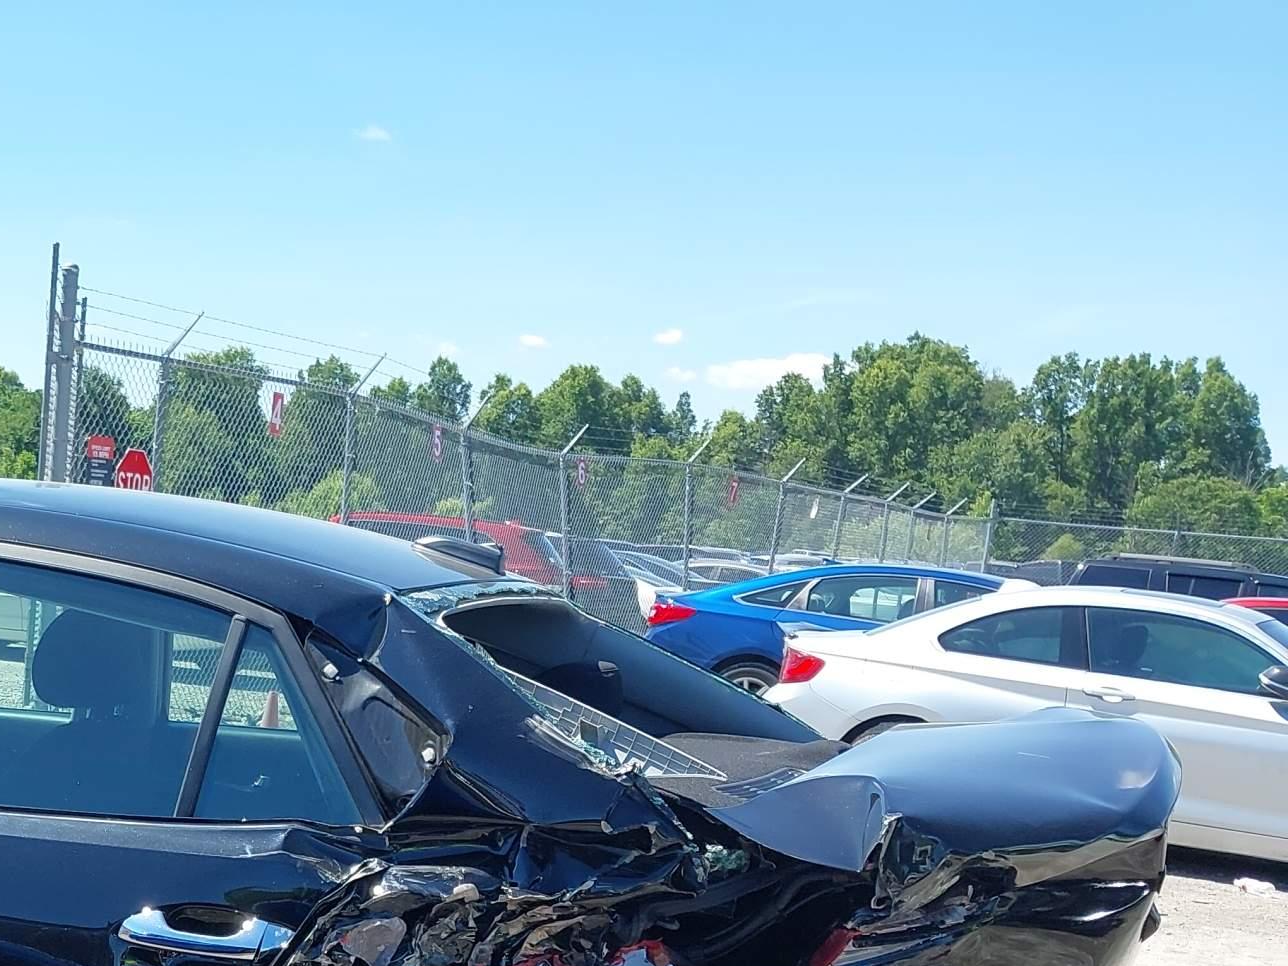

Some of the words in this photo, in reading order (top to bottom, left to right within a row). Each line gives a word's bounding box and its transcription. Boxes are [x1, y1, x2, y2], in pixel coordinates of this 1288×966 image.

[272, 399, 282, 430] 4
[434, 430, 441, 456] 5
[118, 472, 151, 491] STOP
[578, 462, 586, 484] 6
[730, 481, 738, 501] 7
